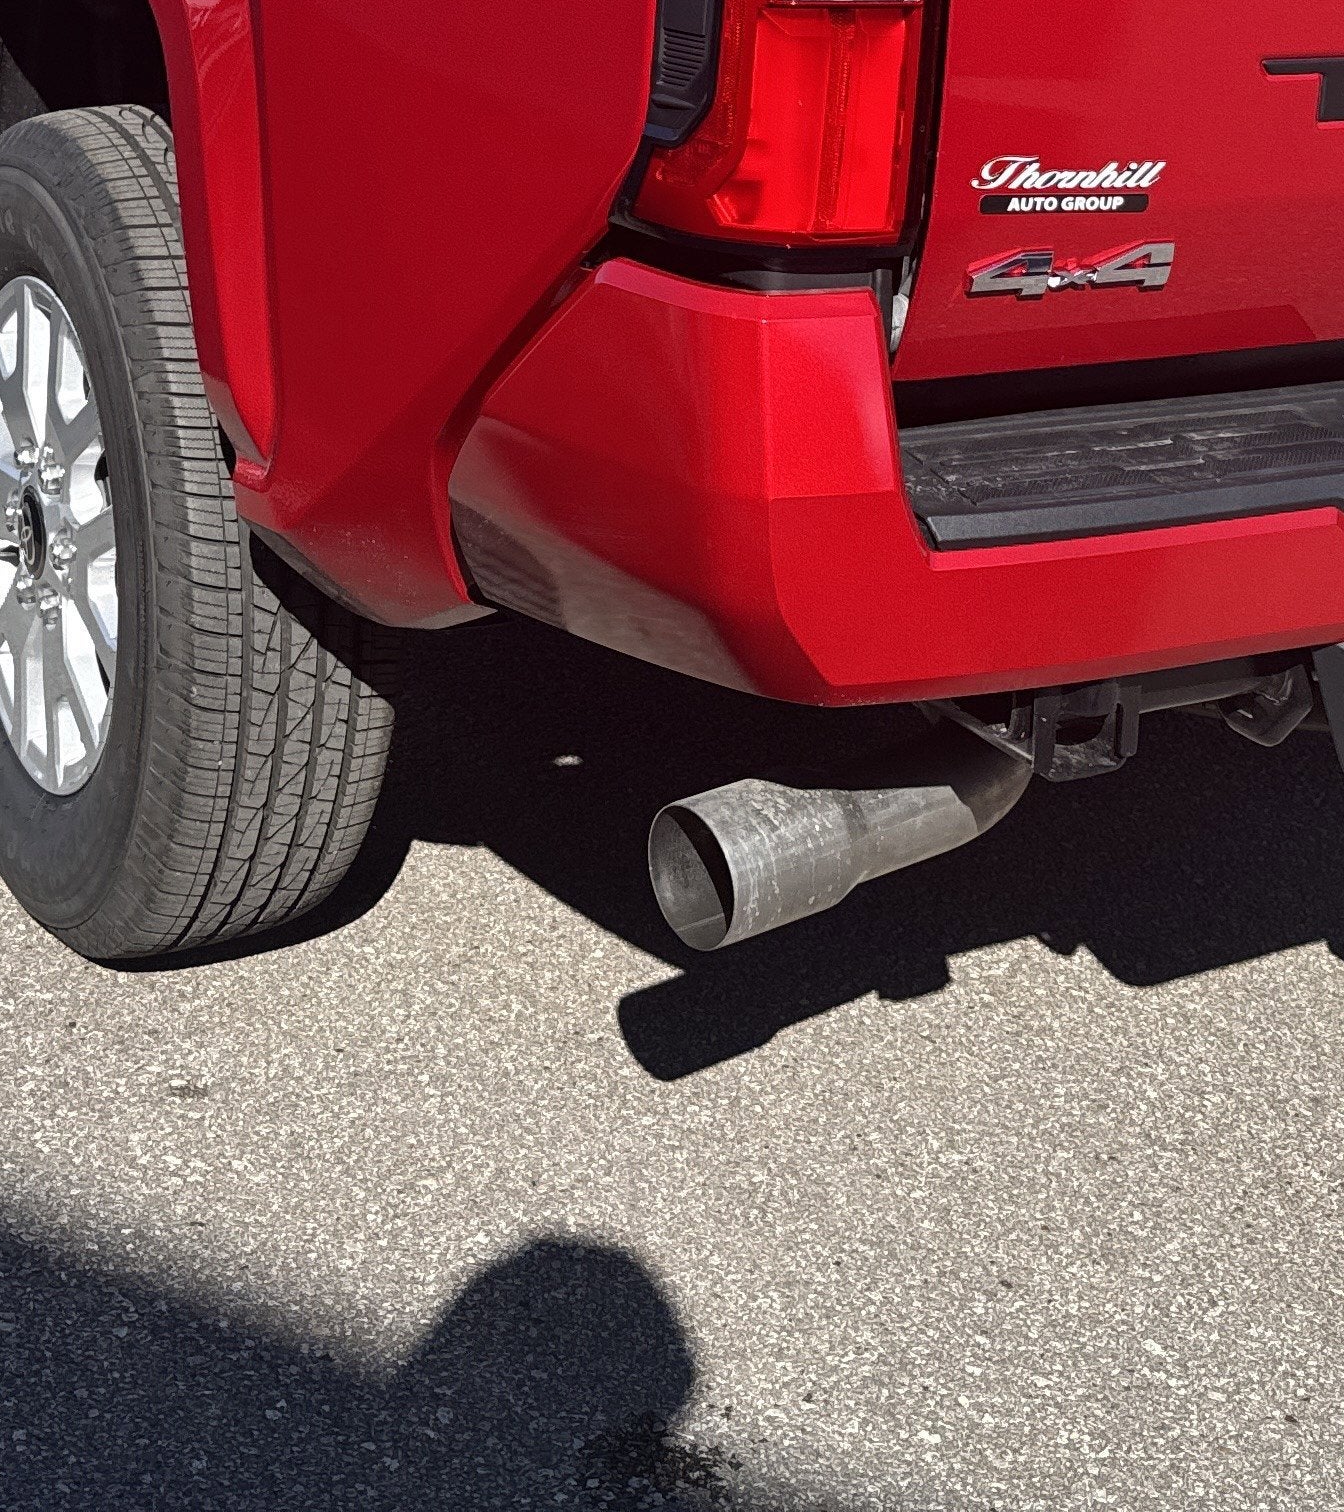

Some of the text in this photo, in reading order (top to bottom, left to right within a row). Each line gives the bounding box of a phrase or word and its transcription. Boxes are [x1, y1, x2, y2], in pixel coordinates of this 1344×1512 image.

[970, 154, 1167, 190] Thornhill
[1006, 196, 1124, 212] AUTO GROUP
